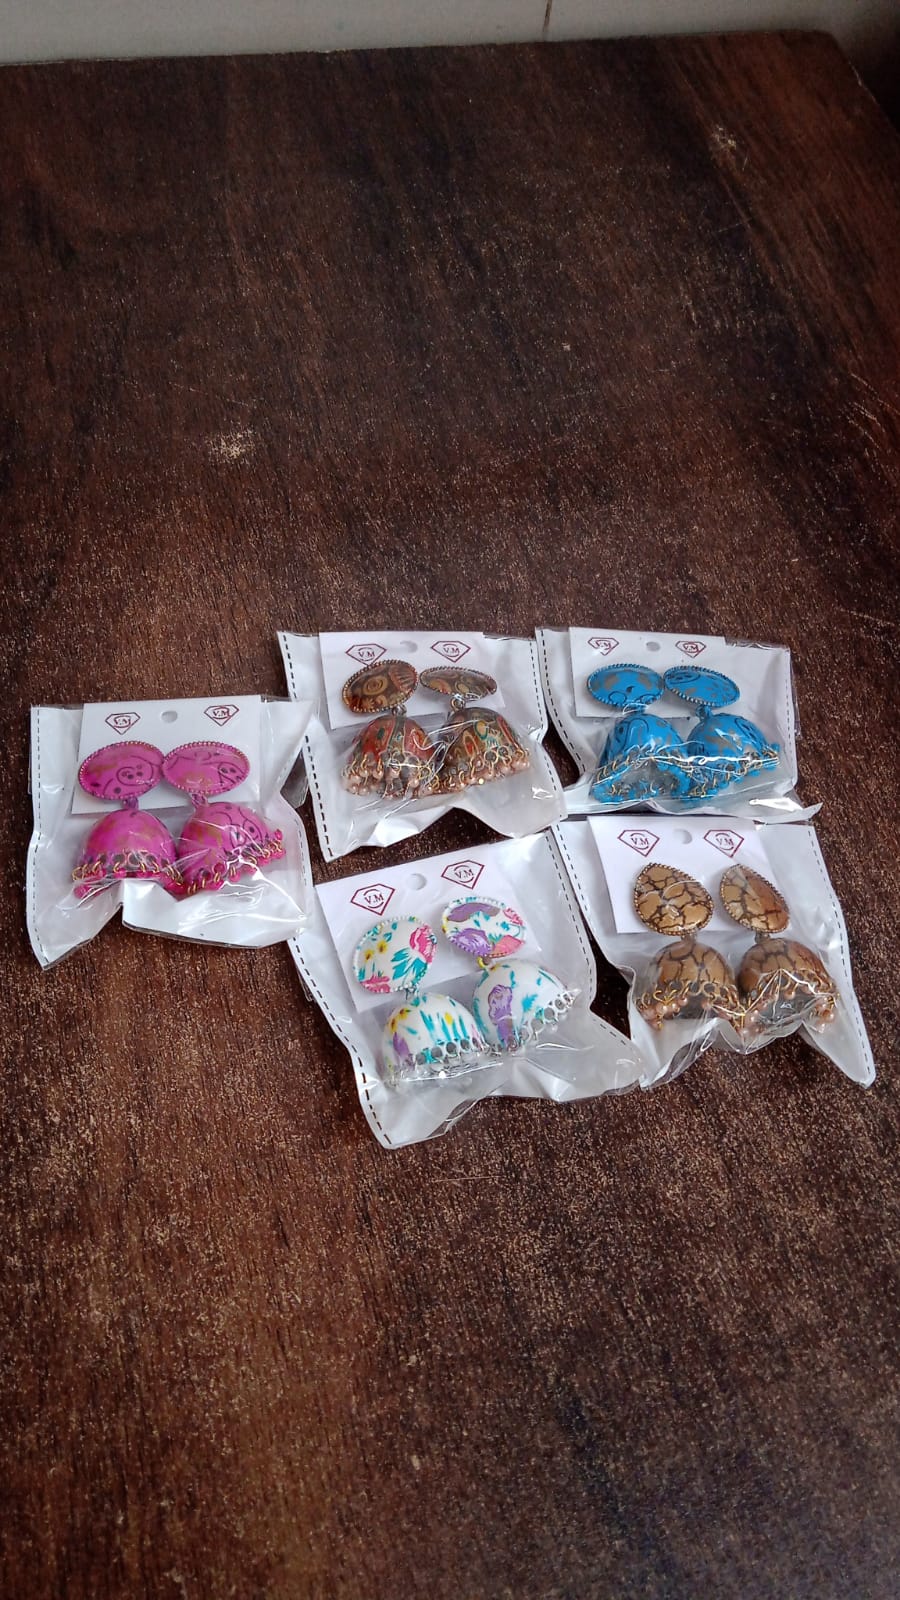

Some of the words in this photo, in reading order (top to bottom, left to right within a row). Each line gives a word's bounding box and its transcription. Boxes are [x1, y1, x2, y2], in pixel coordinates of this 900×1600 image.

[631, 837, 649, 847] V.M
[715, 837, 734, 848] V.M
[454, 868, 474, 879] V.M
[364, 893, 384, 904] V.M
